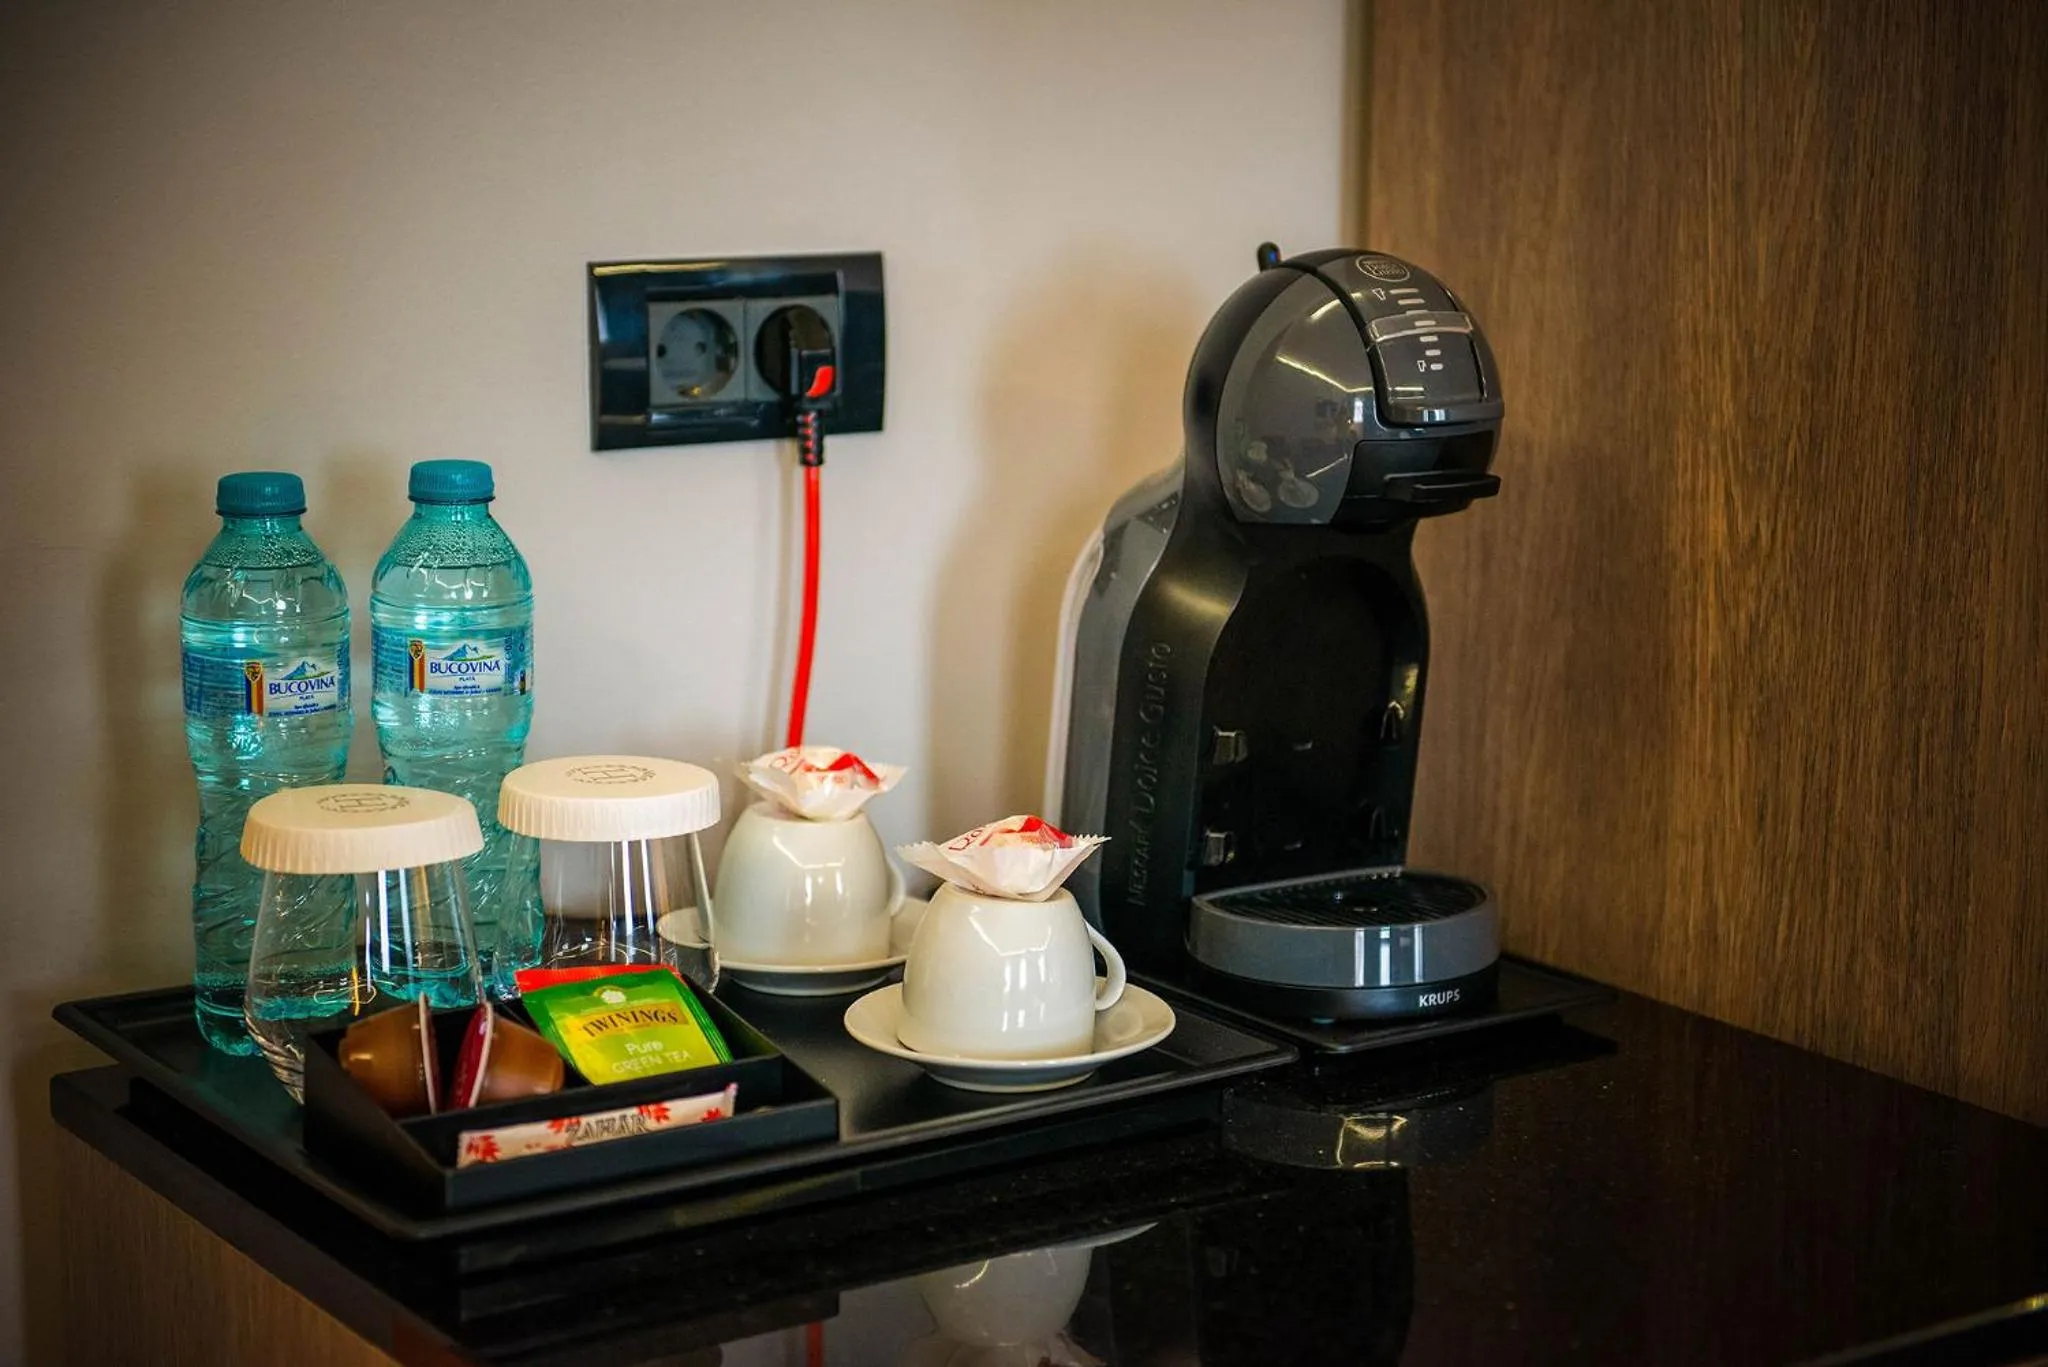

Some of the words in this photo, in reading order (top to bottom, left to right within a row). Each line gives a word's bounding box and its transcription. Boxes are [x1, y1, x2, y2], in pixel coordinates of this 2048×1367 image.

[429, 660, 501, 674] BUCOVINA
[269, 676, 335, 695] BUCOVINA
[1419, 988, 1461, 1007] KRUPS
[582, 1009, 679, 1037] TWININGS
[624, 1040, 664, 1055] Pure
[611, 1053, 663, 1074] GREEN
[664, 1049, 692, 1063] TEA
